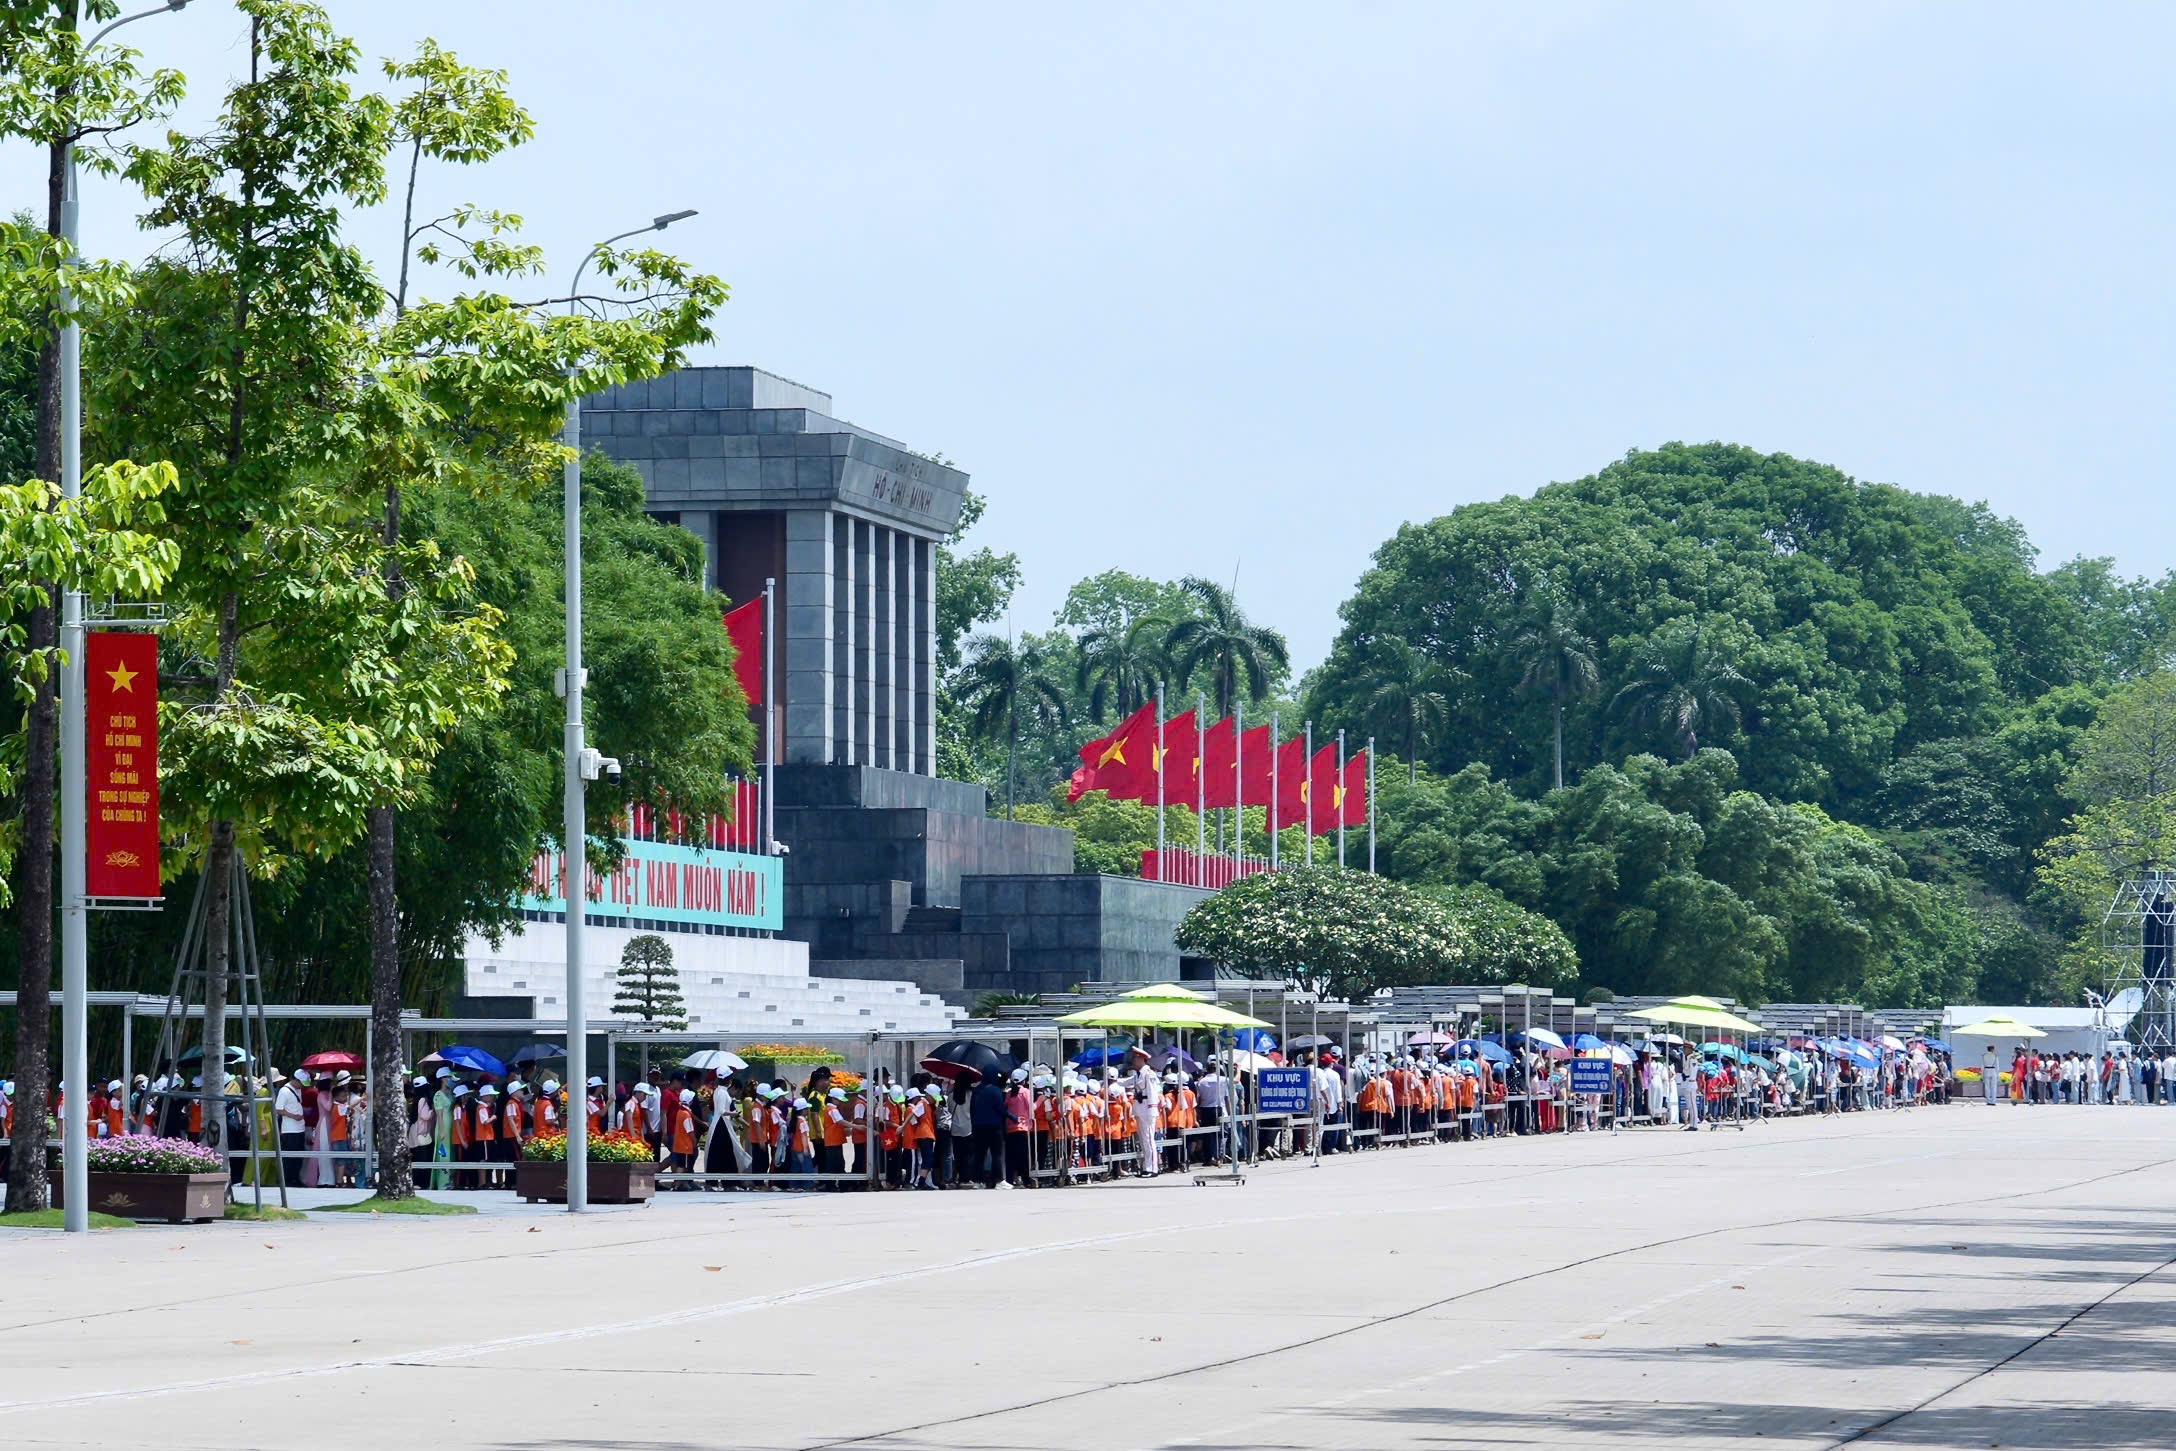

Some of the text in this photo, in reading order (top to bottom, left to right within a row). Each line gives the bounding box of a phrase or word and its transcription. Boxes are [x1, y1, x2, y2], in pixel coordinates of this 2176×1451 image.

[110, 711, 137, 731] CHỦ TỊCH
[105, 730, 142, 748] HỒ CHÍ MINH
[114, 750, 133, 769] VĨ ĐẠI
[110, 767, 139, 784] SỐNG MÃI
[98, 789, 150, 807] TRONG SỰ NGHIỆP
[102, 805, 115, 822] CỦA
[115, 807, 135, 822] CHÚNG
[135, 810, 143, 822] TA
[611, 848, 640, 913] VIỆT
[646, 859, 677, 909] NAM
[683, 857, 721, 913] MUÔN
[727, 860, 756, 916] NĂM
[761, 872, 765, 917] !
[1266, 1072, 1301, 1085] KHU VỰC
